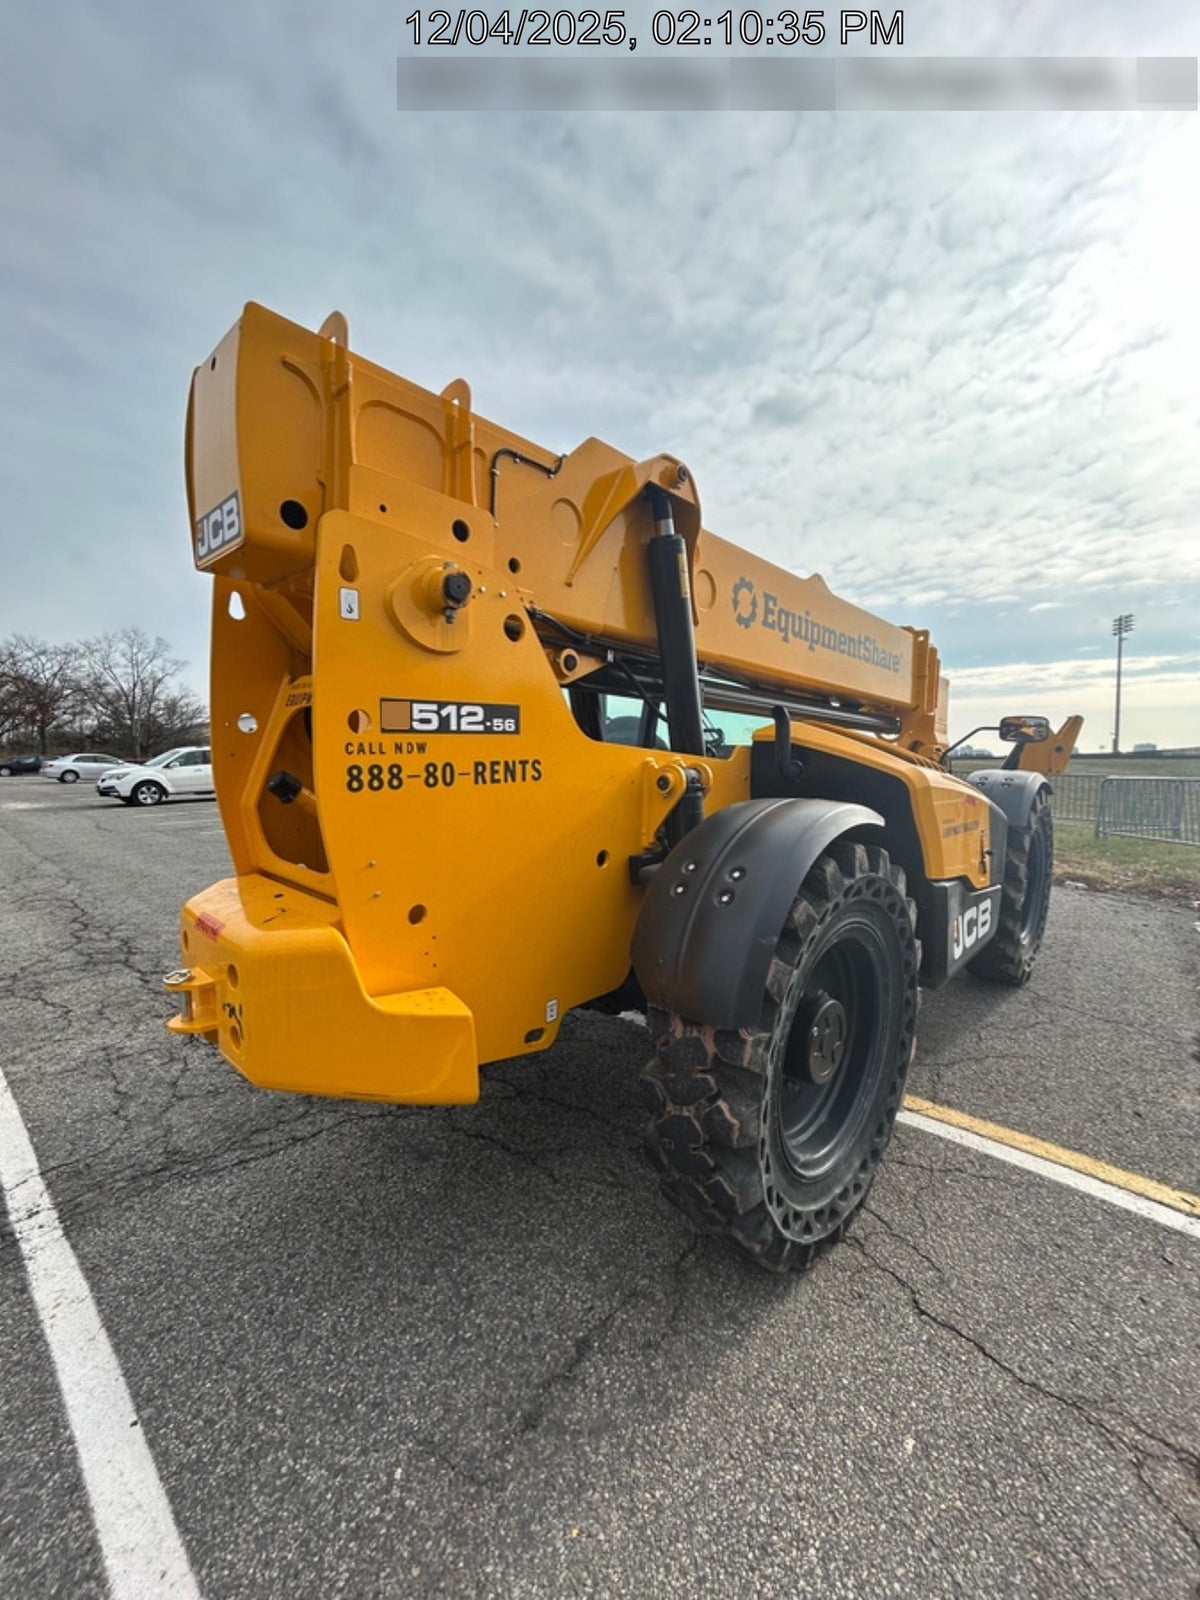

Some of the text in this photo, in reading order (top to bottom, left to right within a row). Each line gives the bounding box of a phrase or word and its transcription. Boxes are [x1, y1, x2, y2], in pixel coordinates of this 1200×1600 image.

[198, 497, 239, 557] JCB
[761, 592, 900, 672] EquipmentShare
[345, 742, 427, 755] CALL NOW
[346, 759, 543, 793] 888-80-RENTS
[953, 899, 992, 960] JCB
